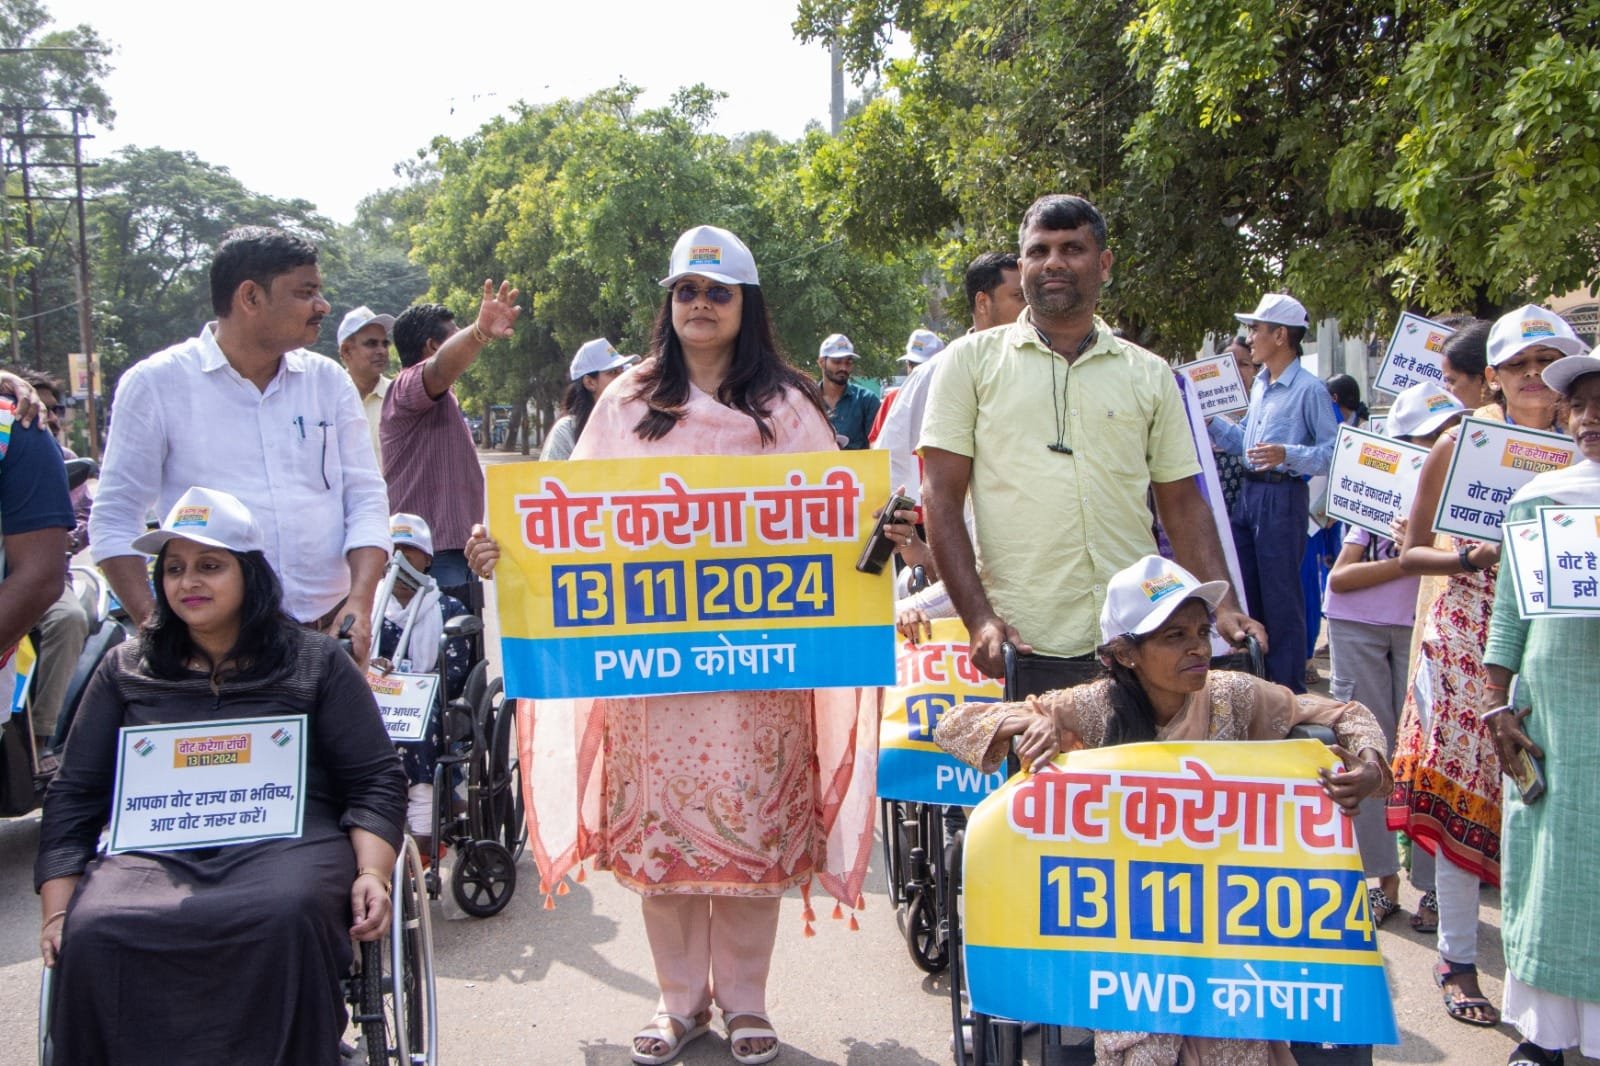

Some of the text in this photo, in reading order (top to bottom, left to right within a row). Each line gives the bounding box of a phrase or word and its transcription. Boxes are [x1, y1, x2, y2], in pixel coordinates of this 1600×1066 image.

[1393, 353, 1443, 380] वोट है भविष्य
[1392, 374, 1409, 388] इसे
[1508, 441, 1569, 465] वोट करेगा रांची
[1513, 458, 1522, 469] 13
[1524, 460, 1534, 470] 11
[1341, 475, 1353, 493] वोट
[1352, 480, 1365, 497] करें
[1364, 484, 1394, 506] वफादारी
[1467, 480, 1492, 501] वोट
[518, 470, 860, 550] वोट करेगा रांची
[1333, 494, 1394, 526] चयन करें समझदारी
[1450, 504, 1482, 524] चयन
[1556, 550, 1598, 571] वोट है
[557, 561, 828, 620] 13 11 2024
[1571, 575, 1598, 598] इसे
[594, 633, 797, 681] PWD कोषांग
[392, 706, 422, 718] आधार,
[178, 736, 248, 754] वोट करेगा रांची
[187, 753, 237, 767] 13 11 2024
[936, 764, 1005, 795] PWD
[125, 782, 295, 812] आपका वोट राज्य का भविष्य,
[1120, 760, 1285, 844] करेगा
[150, 806, 267, 833] आए वोट जरूर करें।
[1046, 865, 1373, 942] 13 11 2024
[1089, 963, 1344, 1022] PWD कोषांग
